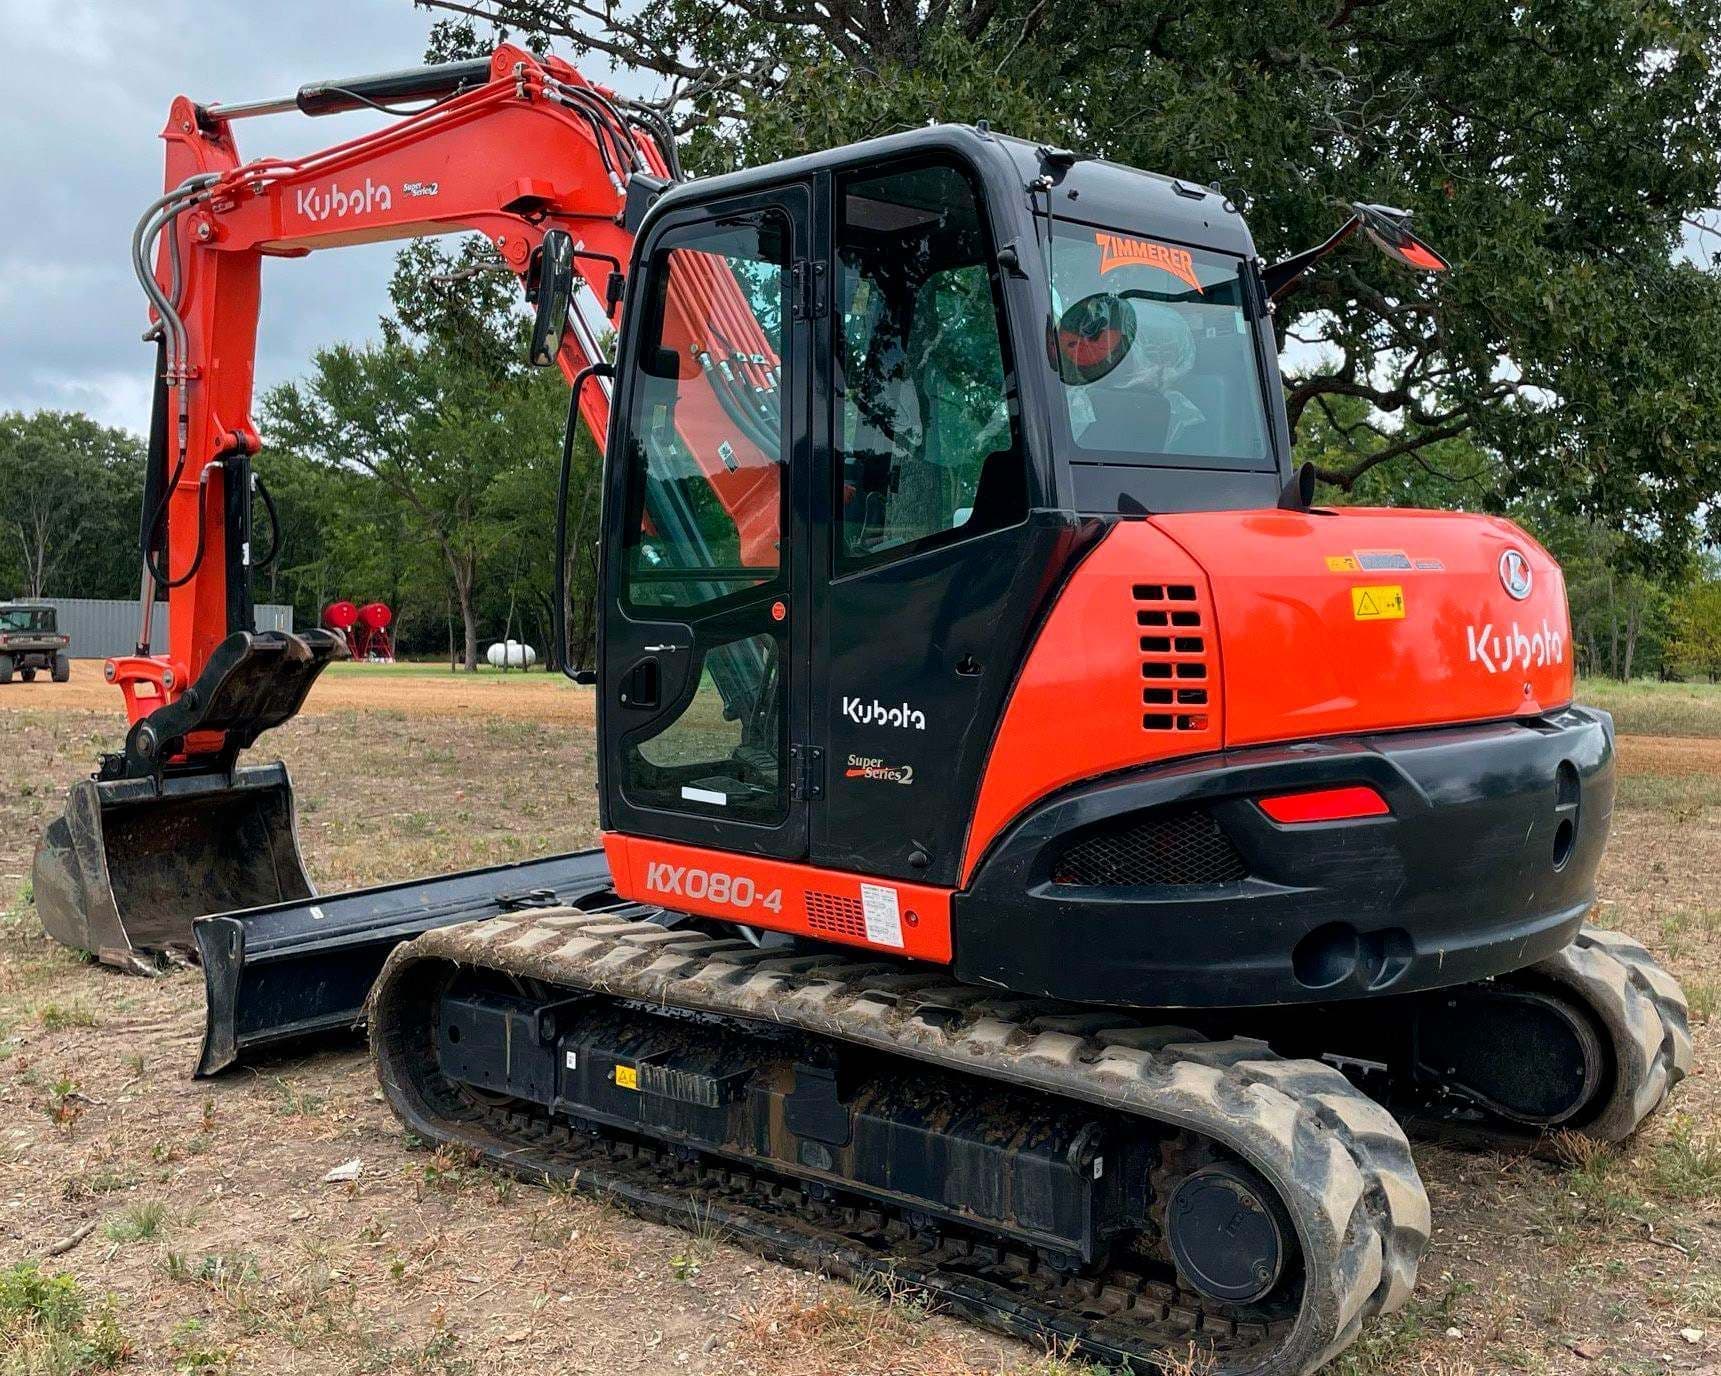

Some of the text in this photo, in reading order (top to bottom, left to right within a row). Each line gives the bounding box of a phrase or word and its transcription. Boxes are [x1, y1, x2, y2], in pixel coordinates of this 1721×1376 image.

[297, 178, 392, 221] Kubota
[1095, 233, 1204, 296] ZIMMERER
[1466, 618, 1562, 674] Kubota
[843, 696, 926, 730] Kubota
[847, 754, 884, 769] Super
[646, 862, 782, 914] KX080-4
